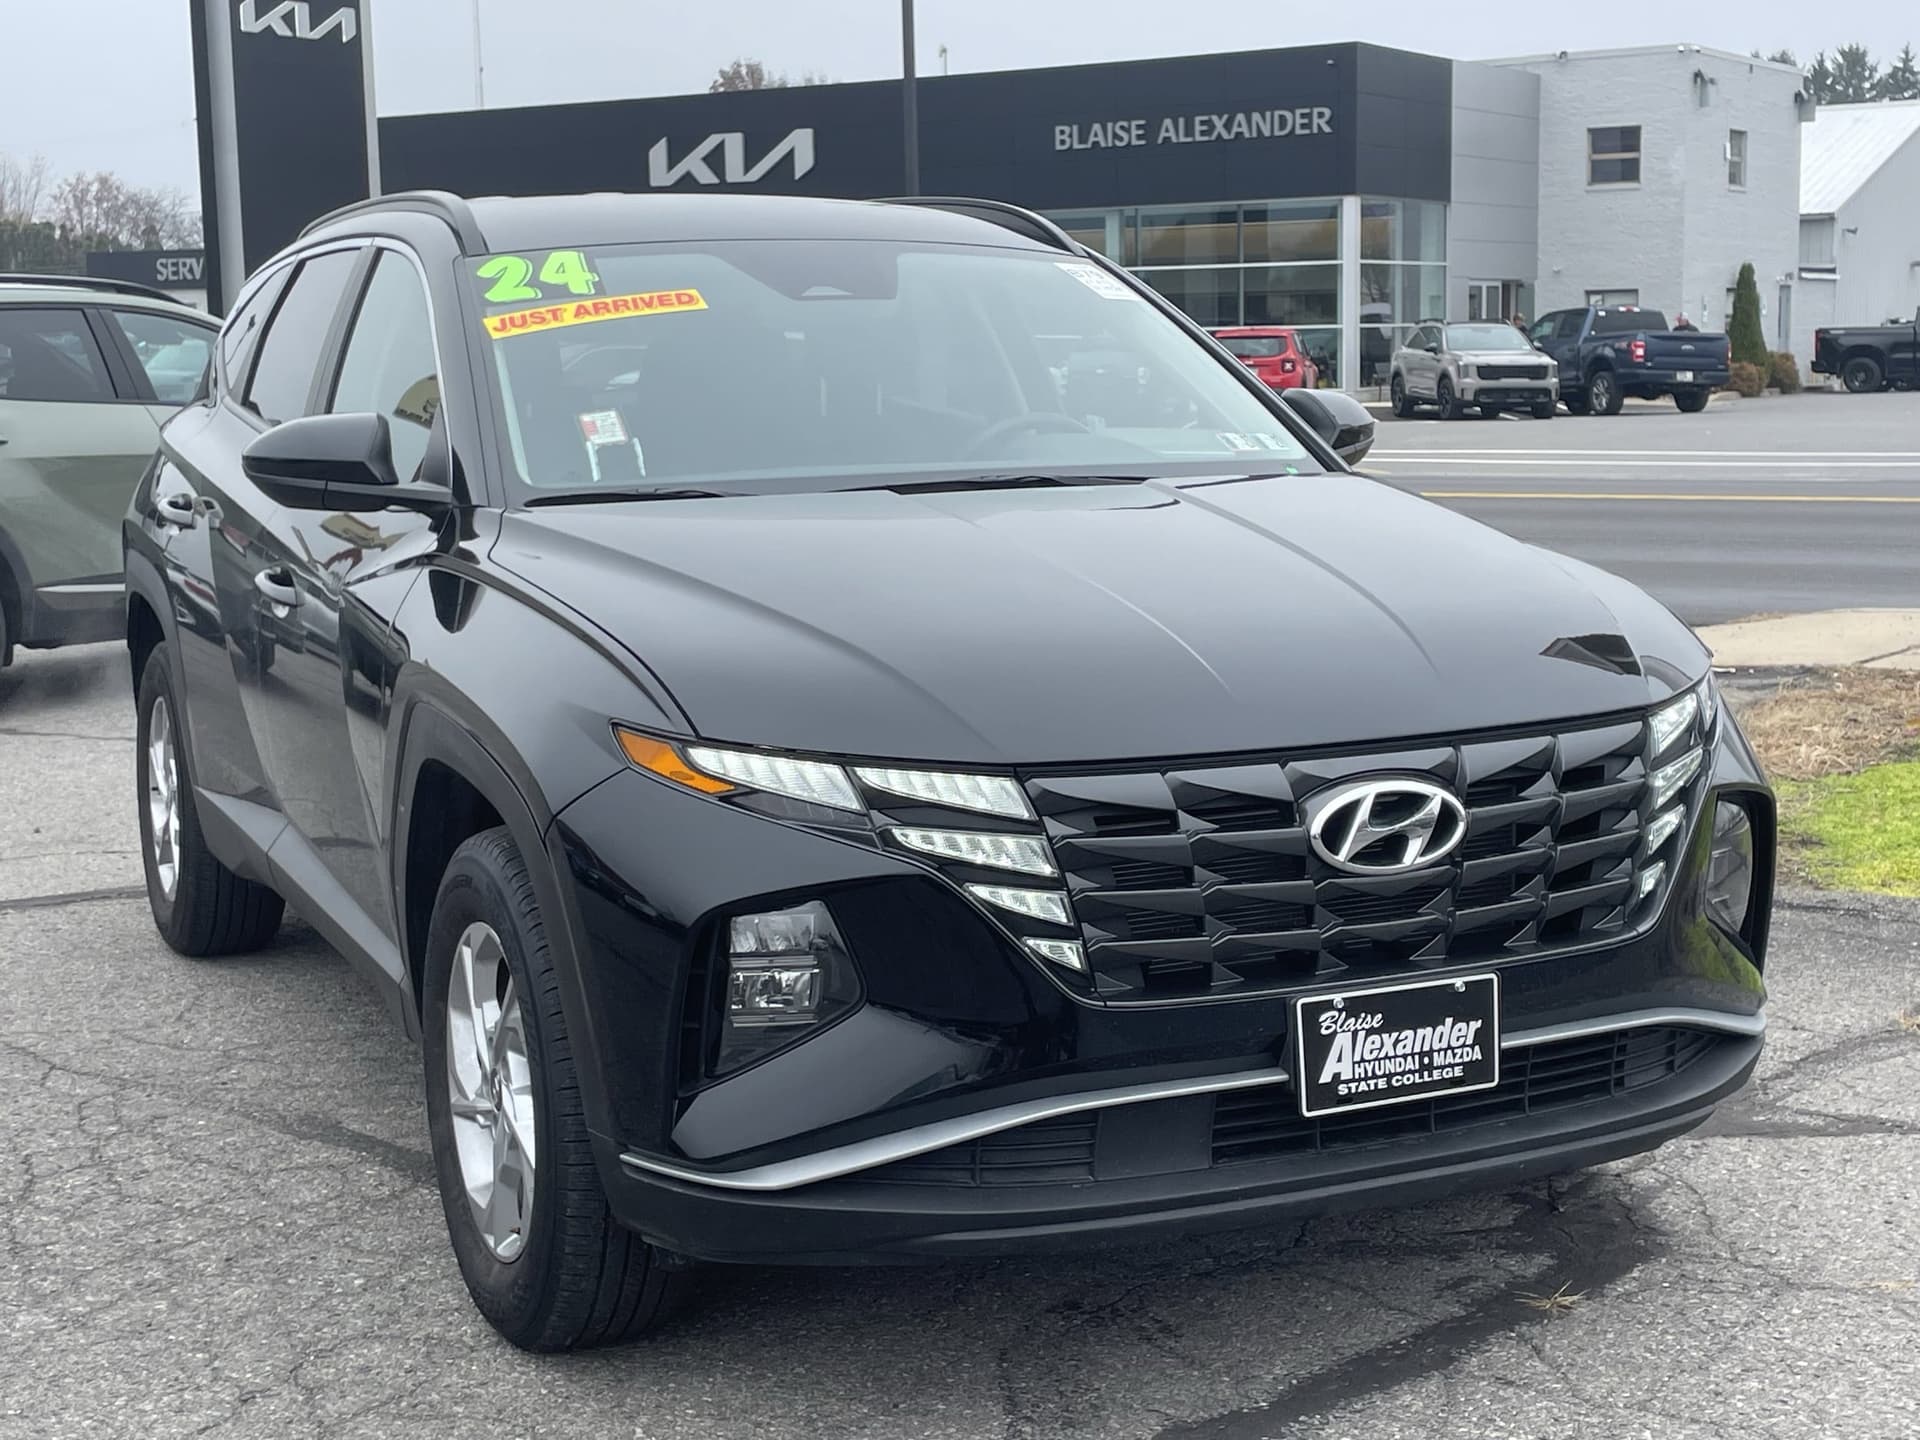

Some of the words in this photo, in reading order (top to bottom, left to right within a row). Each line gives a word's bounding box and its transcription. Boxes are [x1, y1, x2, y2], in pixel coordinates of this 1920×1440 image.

[1054, 119, 1147, 151] BLAISE
[1156, 106, 1333, 145] ALEXANDER
[648, 128, 815, 187] KIA
[476, 250, 600, 303] 24
[492, 307, 567, 333] JUST
[573, 291, 700, 320] ARRIVED
[1318, 1010, 1384, 1035] Blaise
[1318, 1017, 1483, 1084] Alexander
[1354, 1054, 1420, 1079] HYUNDAI
[1433, 1045, 1483, 1067] MAZDA
[1337, 1077, 1388, 1095] STATE
[1391, 1066, 1464, 1087] COLLEGE
